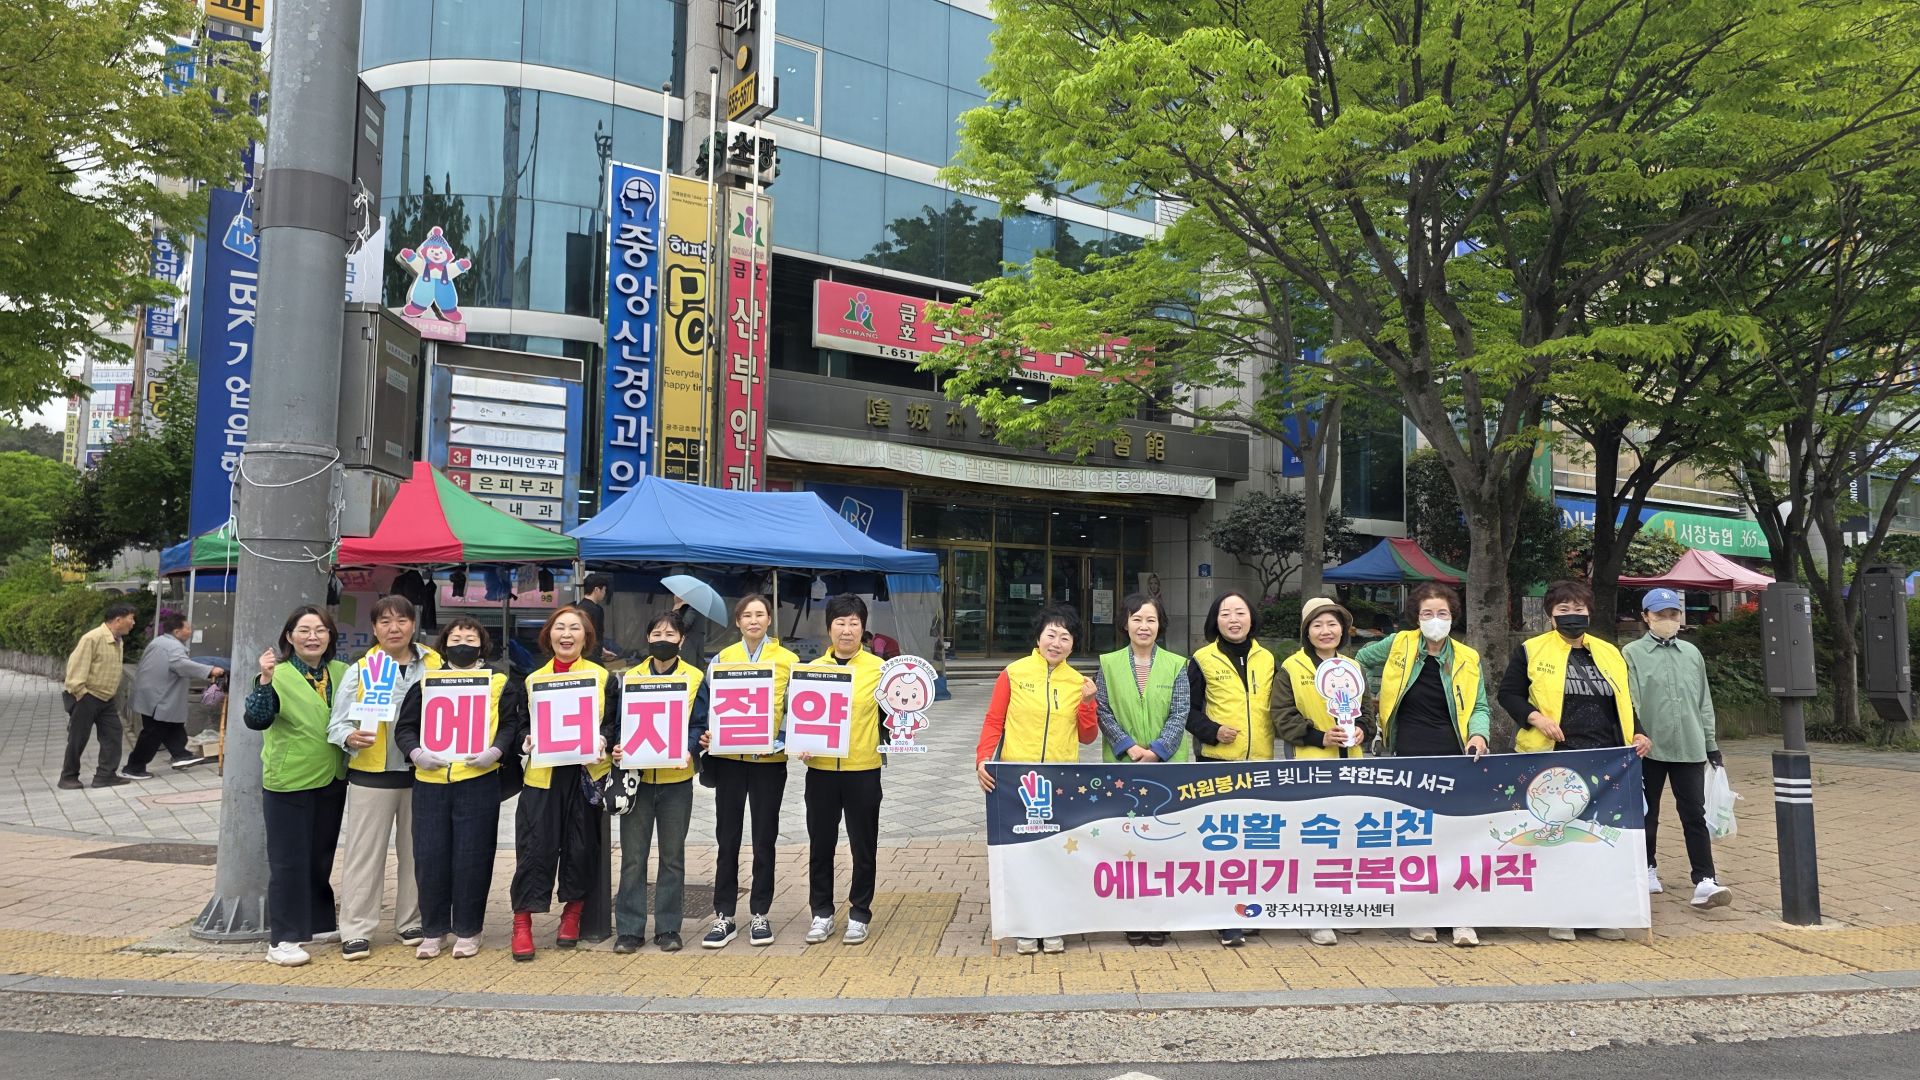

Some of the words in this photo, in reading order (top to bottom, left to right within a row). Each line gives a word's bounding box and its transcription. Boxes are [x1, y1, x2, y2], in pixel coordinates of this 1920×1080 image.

[839, 327, 879, 340] SOMANG
[664, 381, 691, 392] happy
[692, 384, 713, 393] tie
[453, 450, 468, 463] 3F
[476, 453, 559, 471] 하나이비인후과
[1028, 464, 1087, 490] 치매검진
[484, 500, 553, 518] 내과
[1680, 523, 1733, 548] 서창농협
[1740, 529, 1757, 548] 365
[364, 692, 391, 705] 26
[424, 695, 487, 754] 에
[537, 696, 594, 756] 너
[712, 687, 771, 746] 절
[791, 691, 849, 749] 약
[623, 700, 681, 760] 지
[1177, 769, 1270, 802] 자원봉사로
[1277, 766, 1333, 787] 빛나는
[1338, 765, 1413, 789] 착한도시
[1417, 772, 1456, 795] 서구
[1028, 807, 1051, 819] 26
[1197, 812, 1287, 851] 생활
[1299, 812, 1341, 849] 속
[1354, 808, 1434, 849] 실천
[1093, 858, 1299, 900] 에너지위기
[1313, 854, 1439, 895] 극복의
[1452, 851, 1537, 892] 시작
[1264, 902, 1395, 918] 광주서구자원봉사센터
